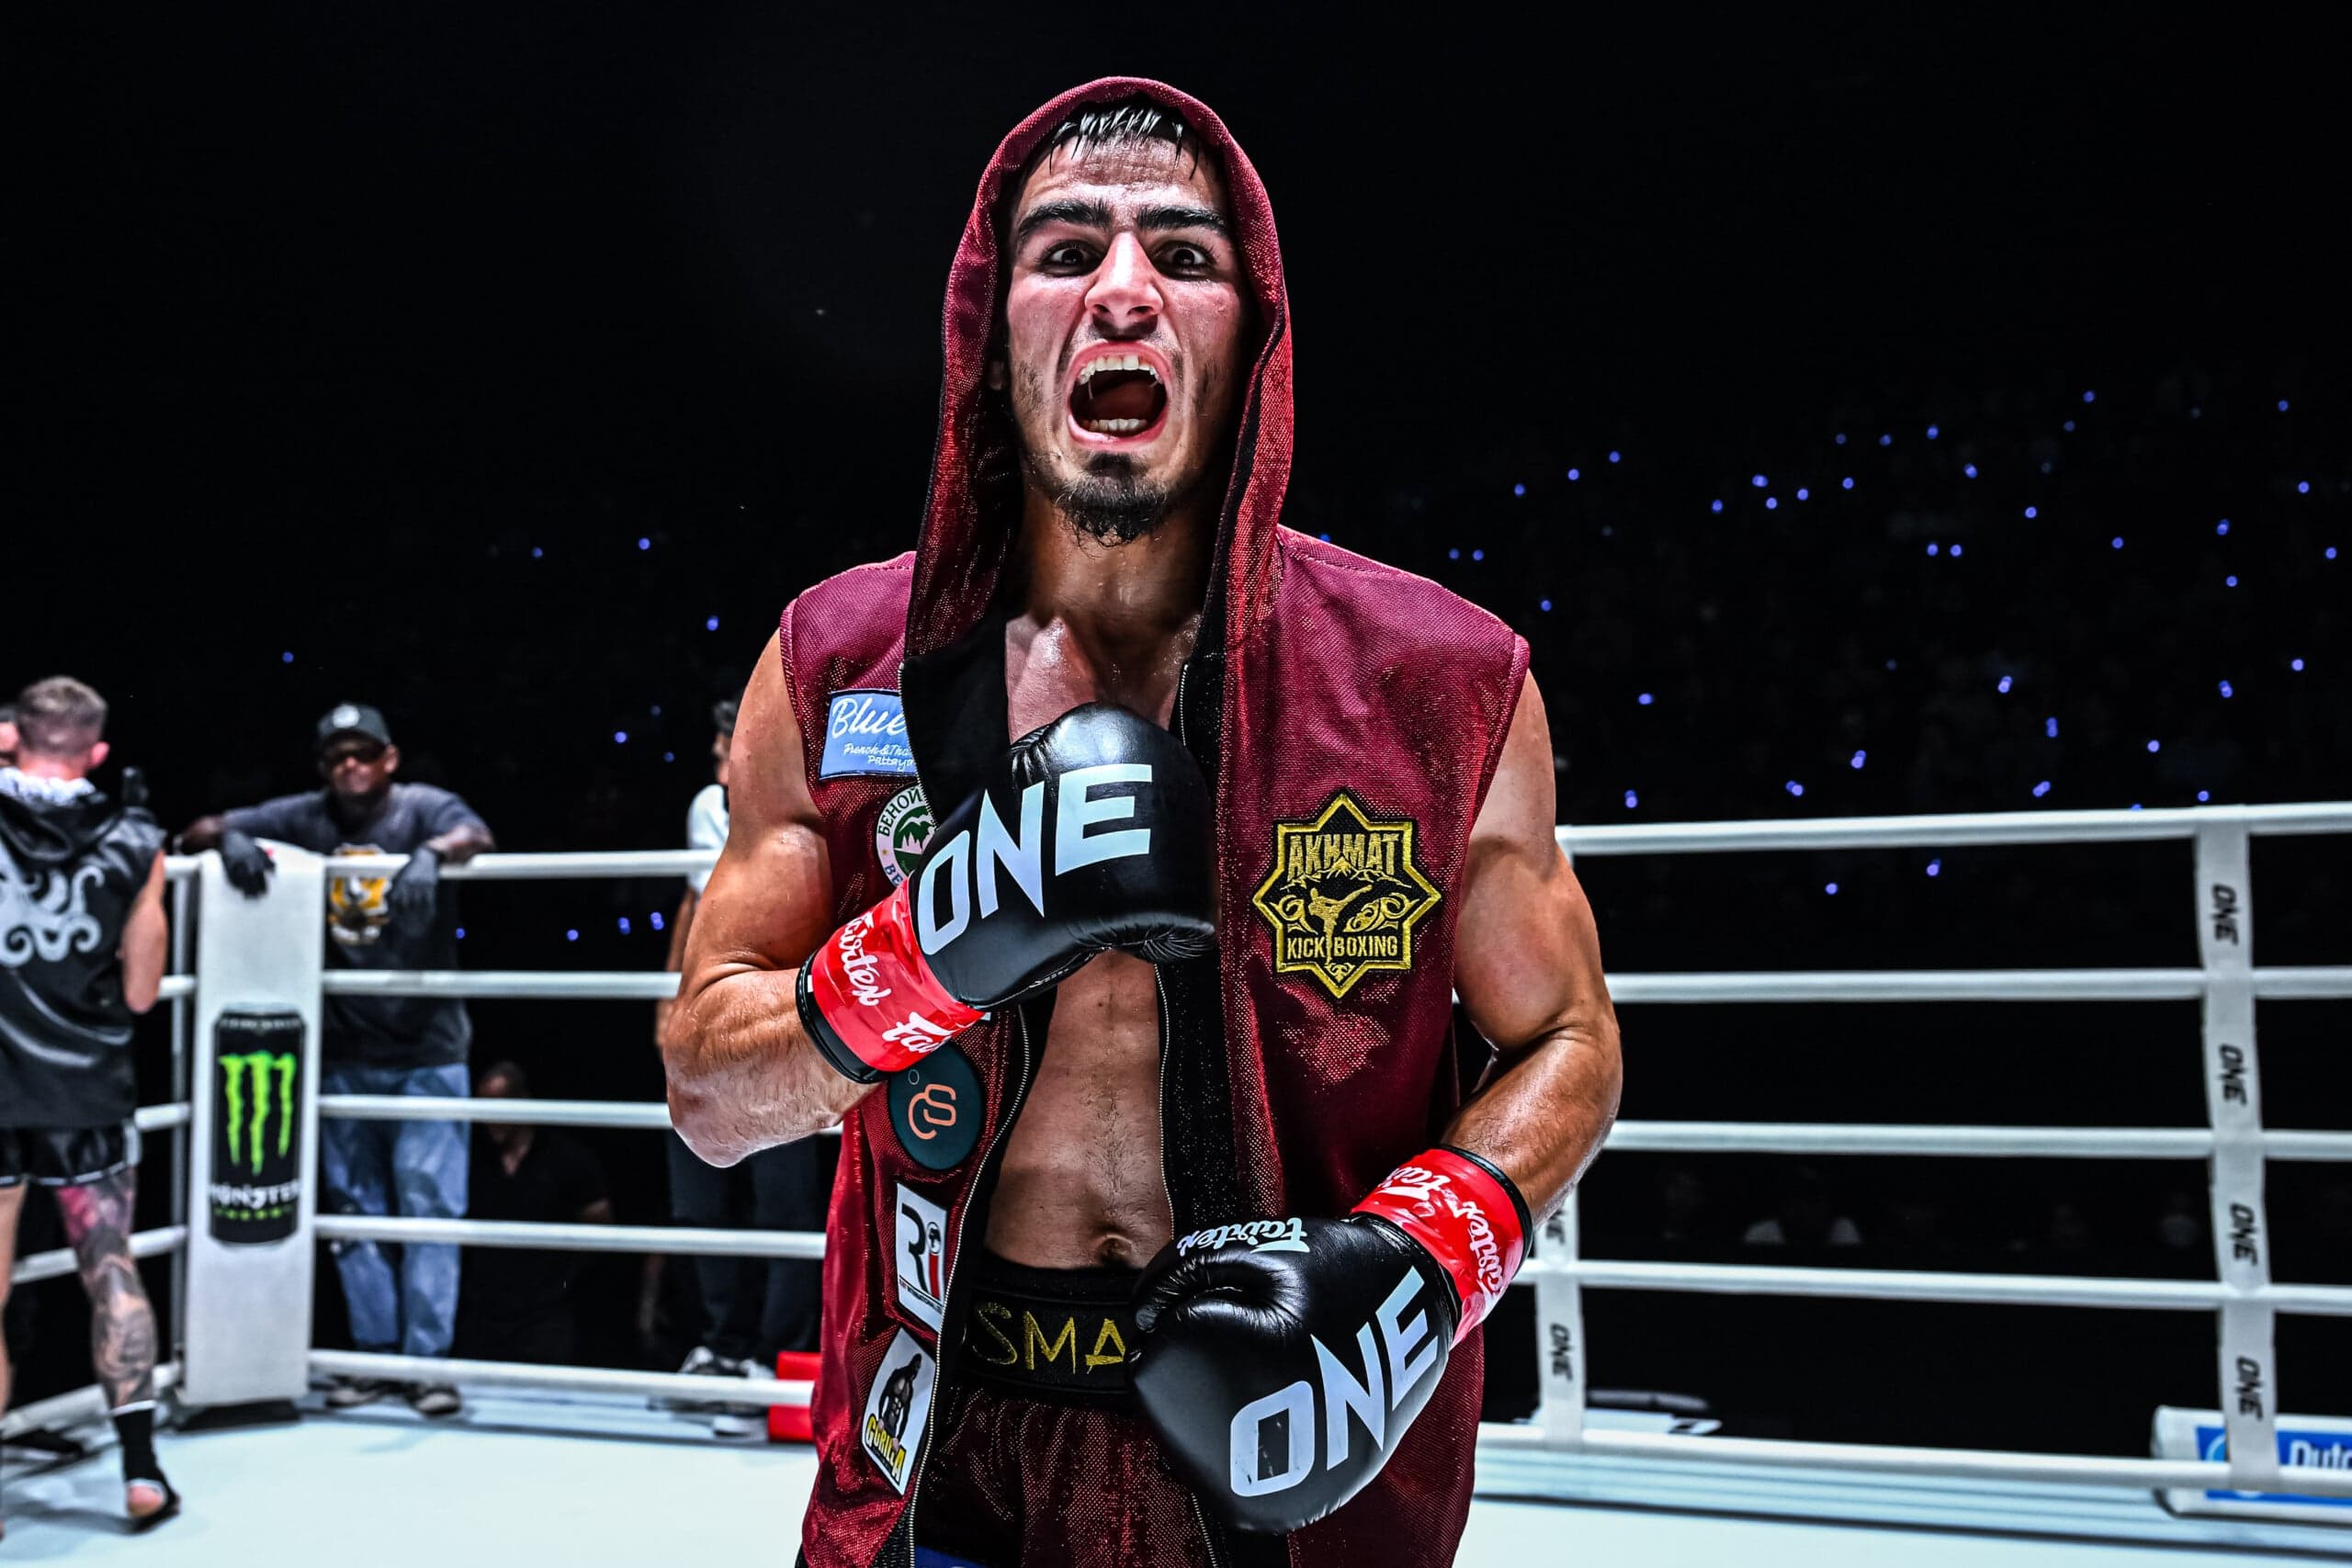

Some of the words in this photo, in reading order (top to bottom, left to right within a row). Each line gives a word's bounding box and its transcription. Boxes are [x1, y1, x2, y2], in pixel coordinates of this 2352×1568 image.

[917, 762, 1153, 955] ONE
[1287, 832, 1400, 882] AKHMAT
[2211, 883, 2240, 946] ONE
[1287, 936, 1325, 960] KICK
[1334, 935, 1398, 958] BOXING
[2218, 1043, 2248, 1106] ONE
[1176, 1217, 1311, 1258] Fairtex
[2227, 1202, 2258, 1267] ONE
[1229, 1265, 1439, 1498] ONE
[1550, 1322, 1574, 1382] ONE
[2235, 1356, 2265, 1422] ONE
